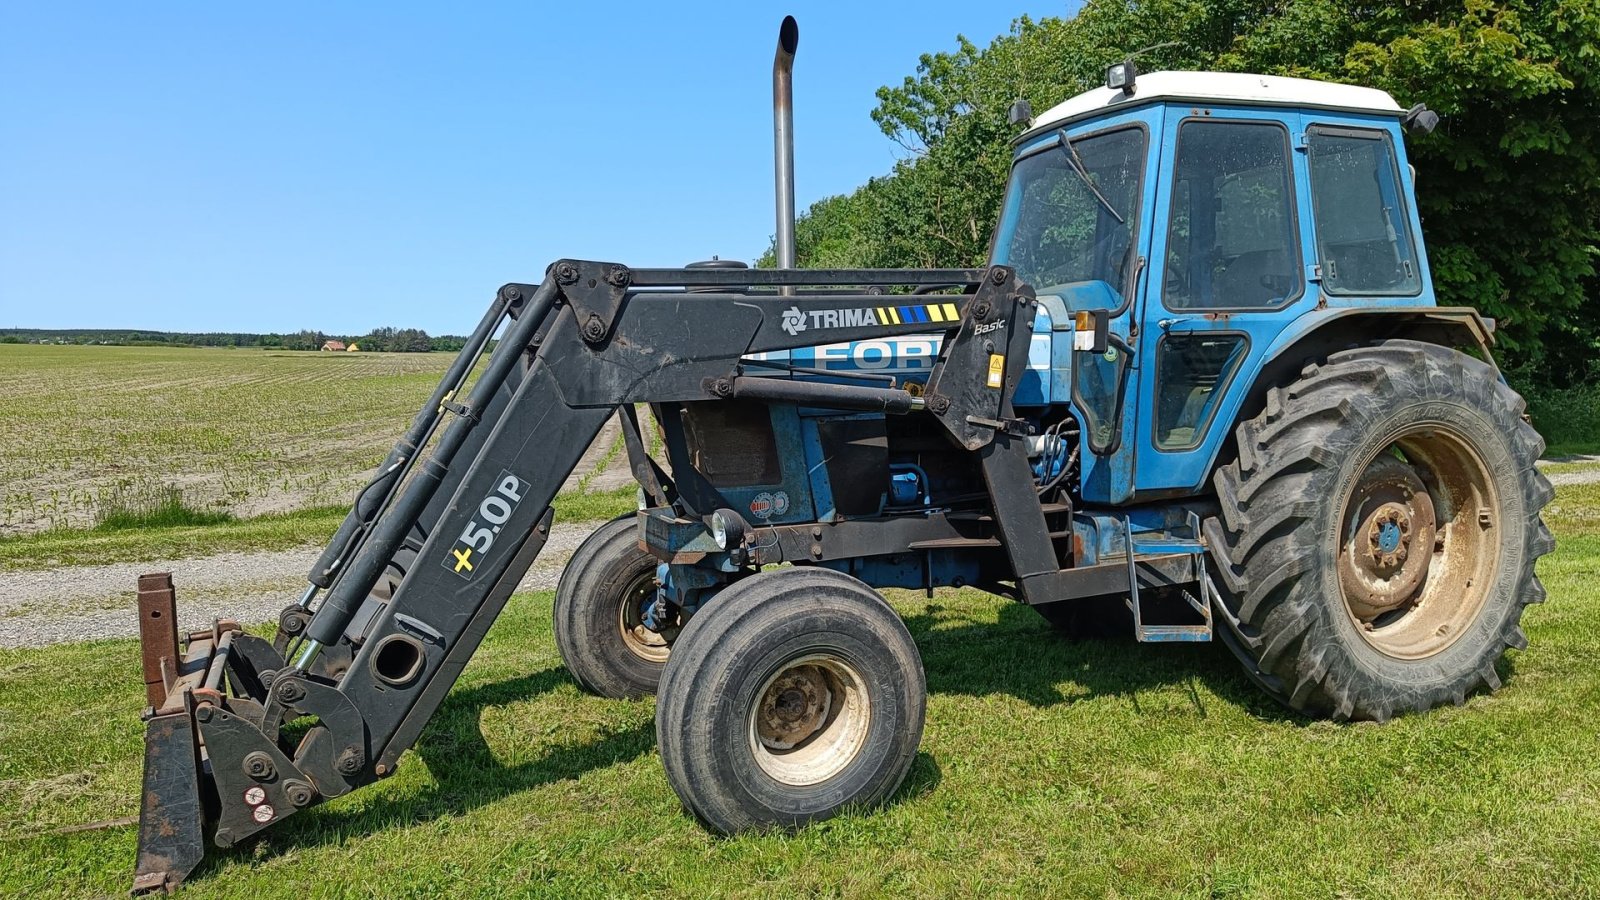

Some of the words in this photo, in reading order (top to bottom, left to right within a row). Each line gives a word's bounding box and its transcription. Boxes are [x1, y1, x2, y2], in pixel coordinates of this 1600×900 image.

[809, 308, 877, 328] TRIMA
[974, 318, 1006, 336] Basic
[814, 341, 942, 370] FOR
